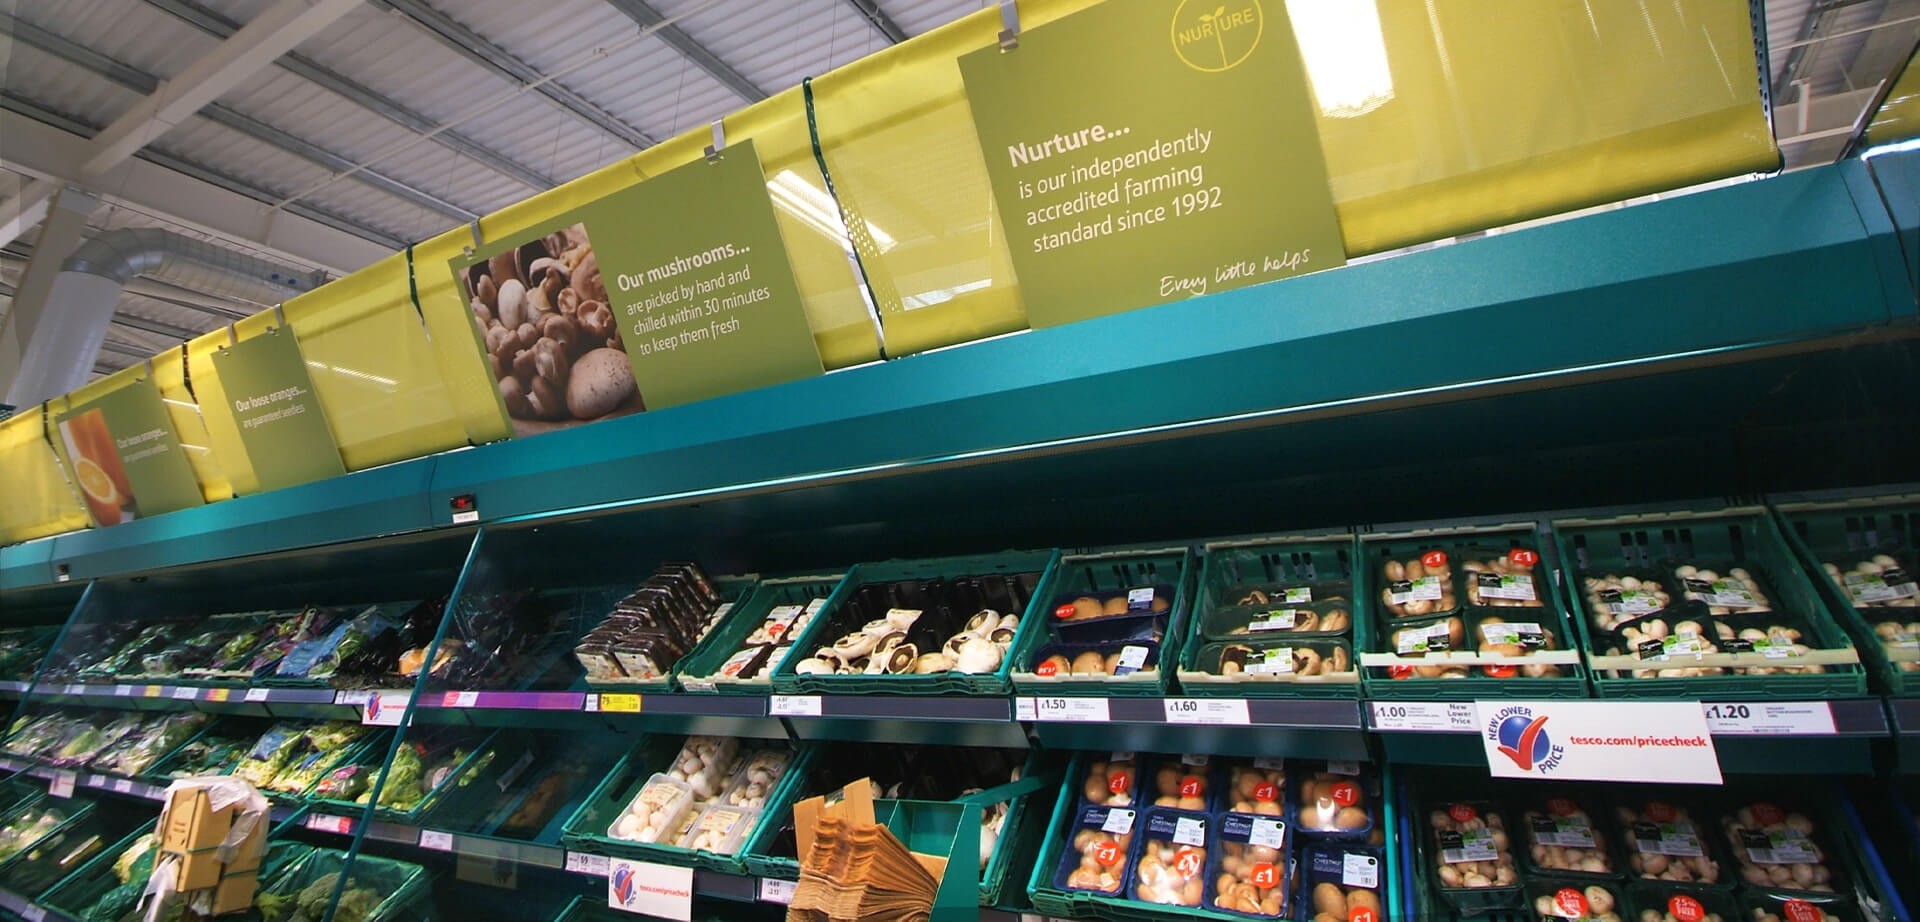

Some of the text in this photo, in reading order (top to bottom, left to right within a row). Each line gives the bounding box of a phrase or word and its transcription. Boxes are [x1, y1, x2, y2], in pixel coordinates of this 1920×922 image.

[1178, 8, 1255, 47] NURTURE
[1008, 123, 1130, 168] Nurture...
[1019, 128, 1213, 199] is our independently
[1026, 163, 1204, 226] accredited farming
[1033, 186, 1223, 253] standard since 1992
[617, 243, 751, 292] Our mushrooms...
[1159, 248, 1311, 297] Every little helps
[626, 265, 751, 316] are picked by hand and
[633, 284, 771, 335] chilled within 30 minutes
[640, 316, 740, 356] to keep them fresh
[235, 399, 250, 412] Our
[249, 395, 270, 408] loose
[1425, 553, 1441, 565] £1
[1514, 551, 1532, 562] £1
[1041, 699, 1066, 710] £1.50
[1169, 701, 1197, 712] £1.60
[1706, 704, 1750, 719] £1.20
[1488, 706, 1532, 740] NEW LOWER
[1570, 735, 1707, 748] tesco.com/pricecheck
[1538, 744, 1564, 774] PRICE
[1111, 776, 1125, 788] £1
[1182, 782, 1197, 794] £1
[1256, 786, 1273, 799] £1
[1334, 788, 1352, 801] £1
[1099, 848, 1116, 861] £1
[1256, 868, 1273, 884] £1
[1353, 911, 1371, 922] £1
